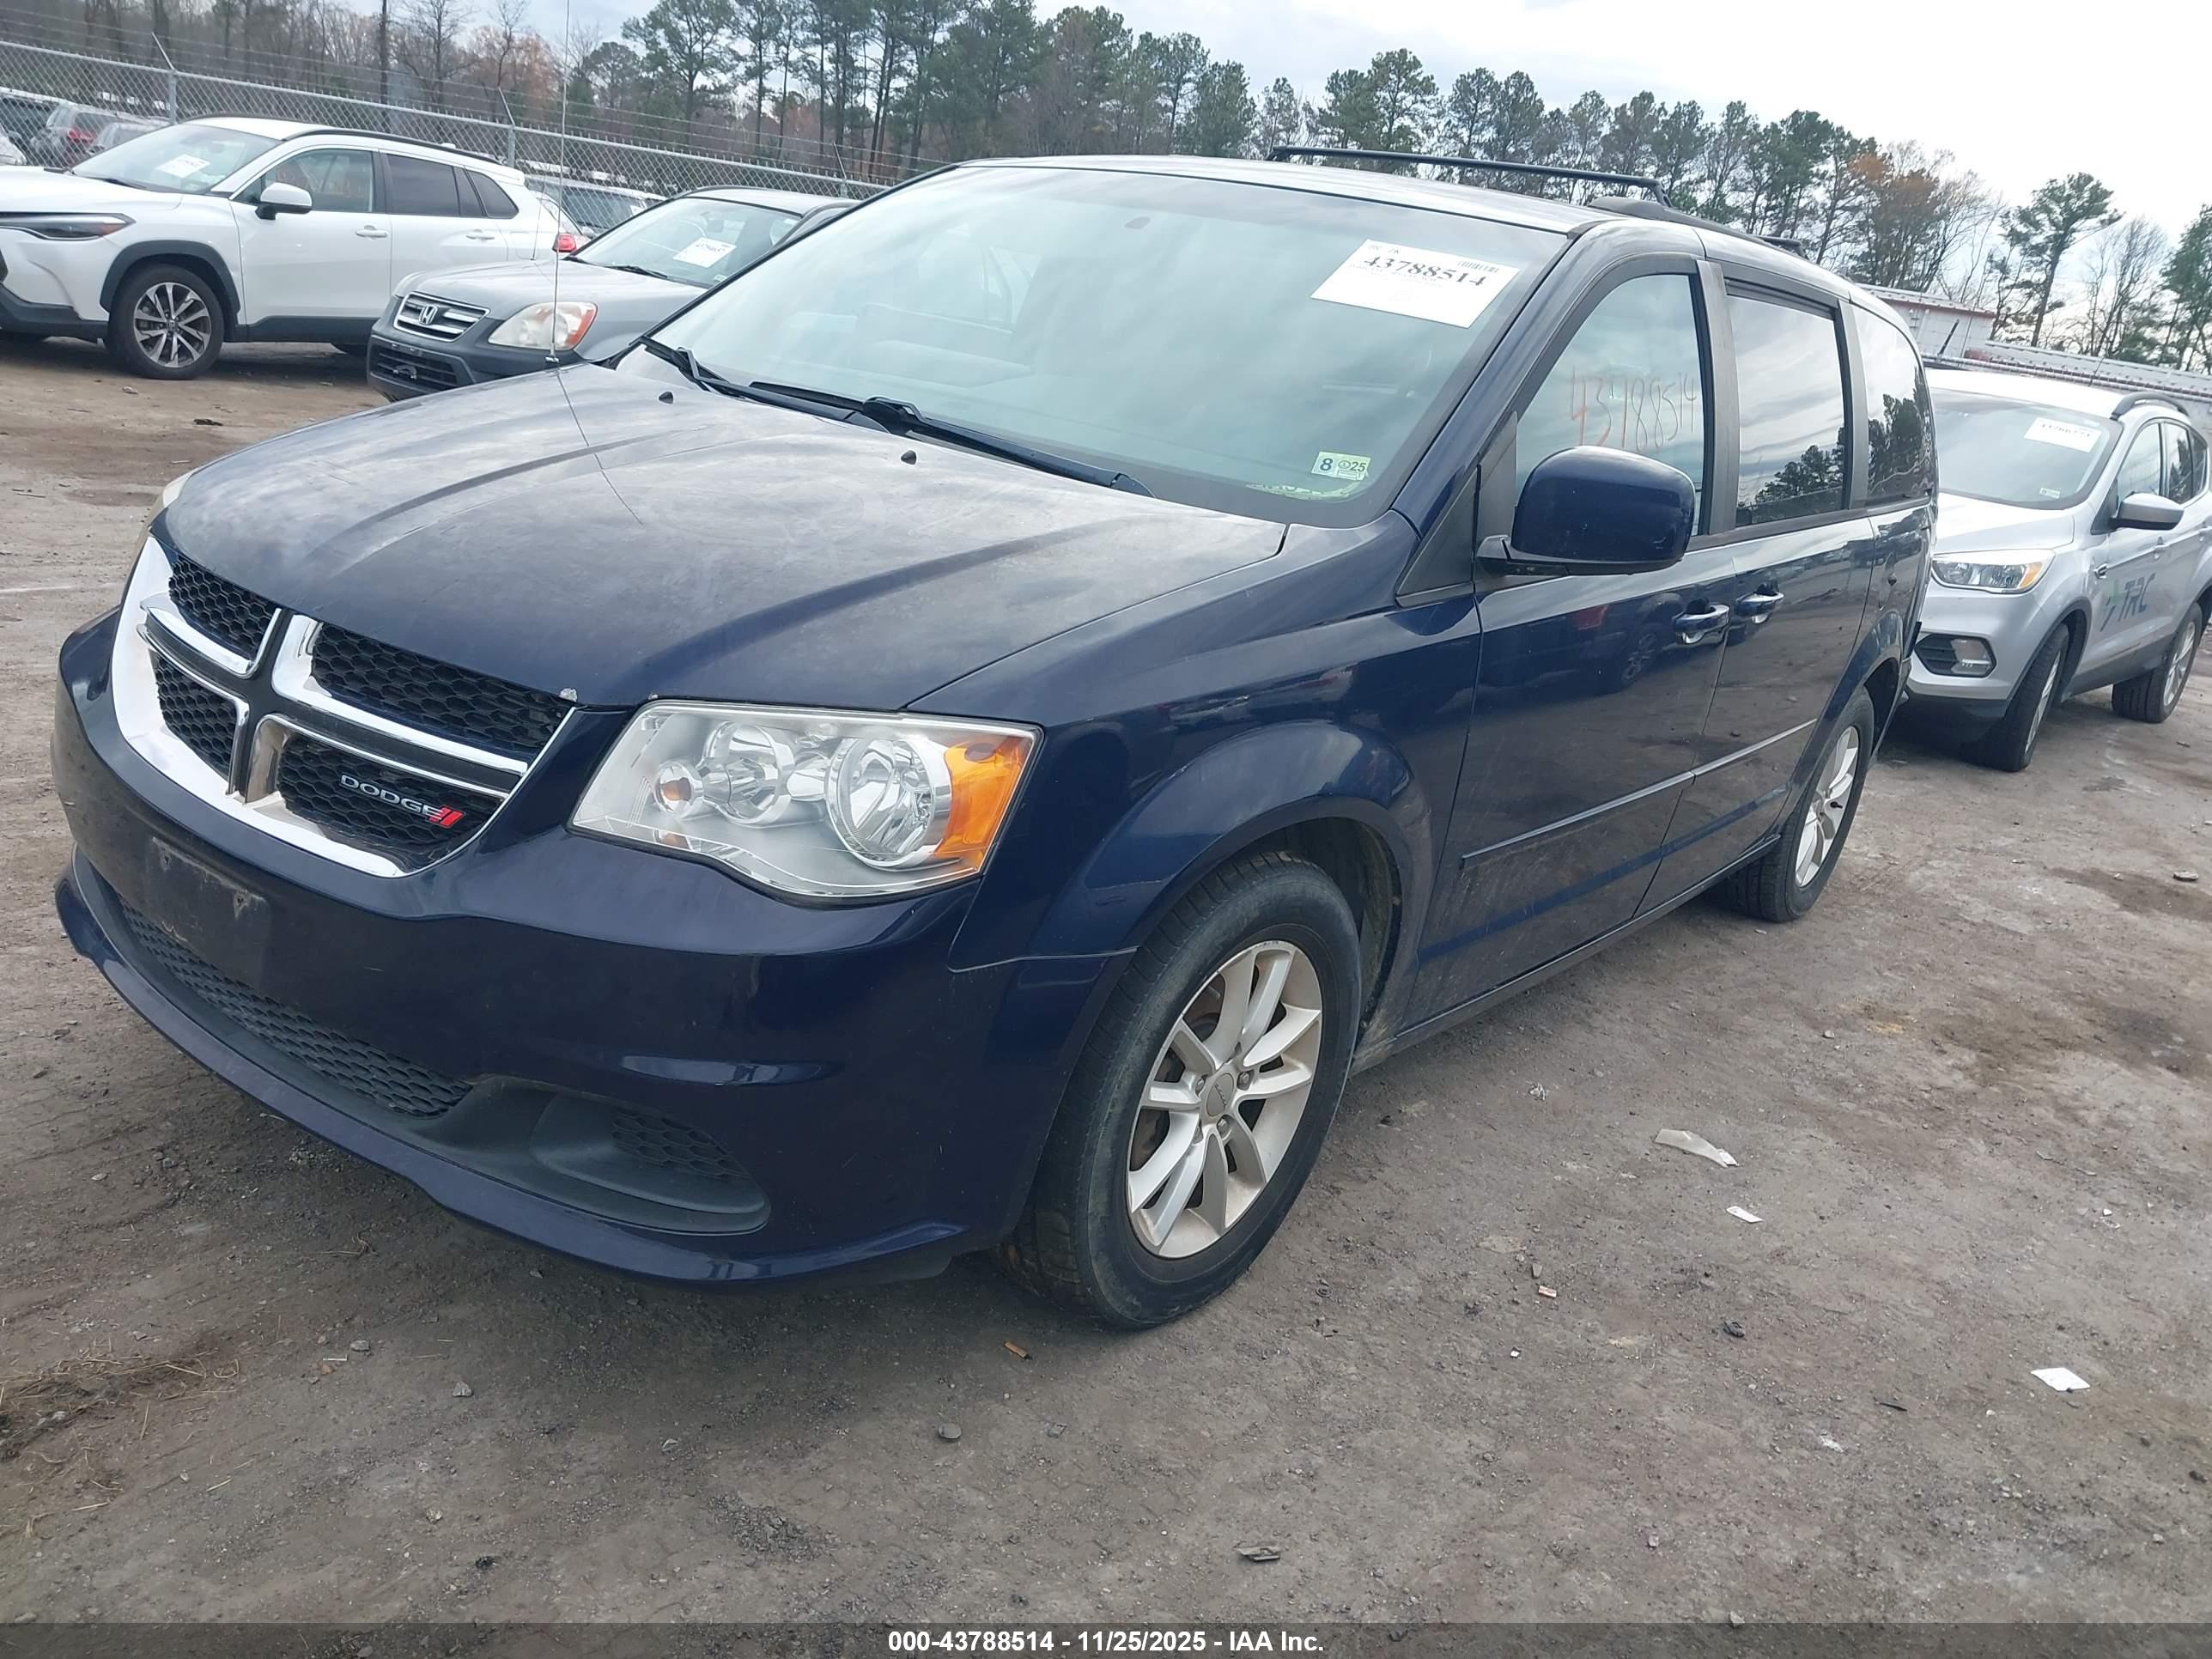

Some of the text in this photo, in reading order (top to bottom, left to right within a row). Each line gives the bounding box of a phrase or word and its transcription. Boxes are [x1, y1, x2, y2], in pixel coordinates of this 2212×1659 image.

[1364, 256, 1487, 287] 43788514
[1319, 458, 1367, 472] 8 25
[339, 774, 444, 821] DODGE
